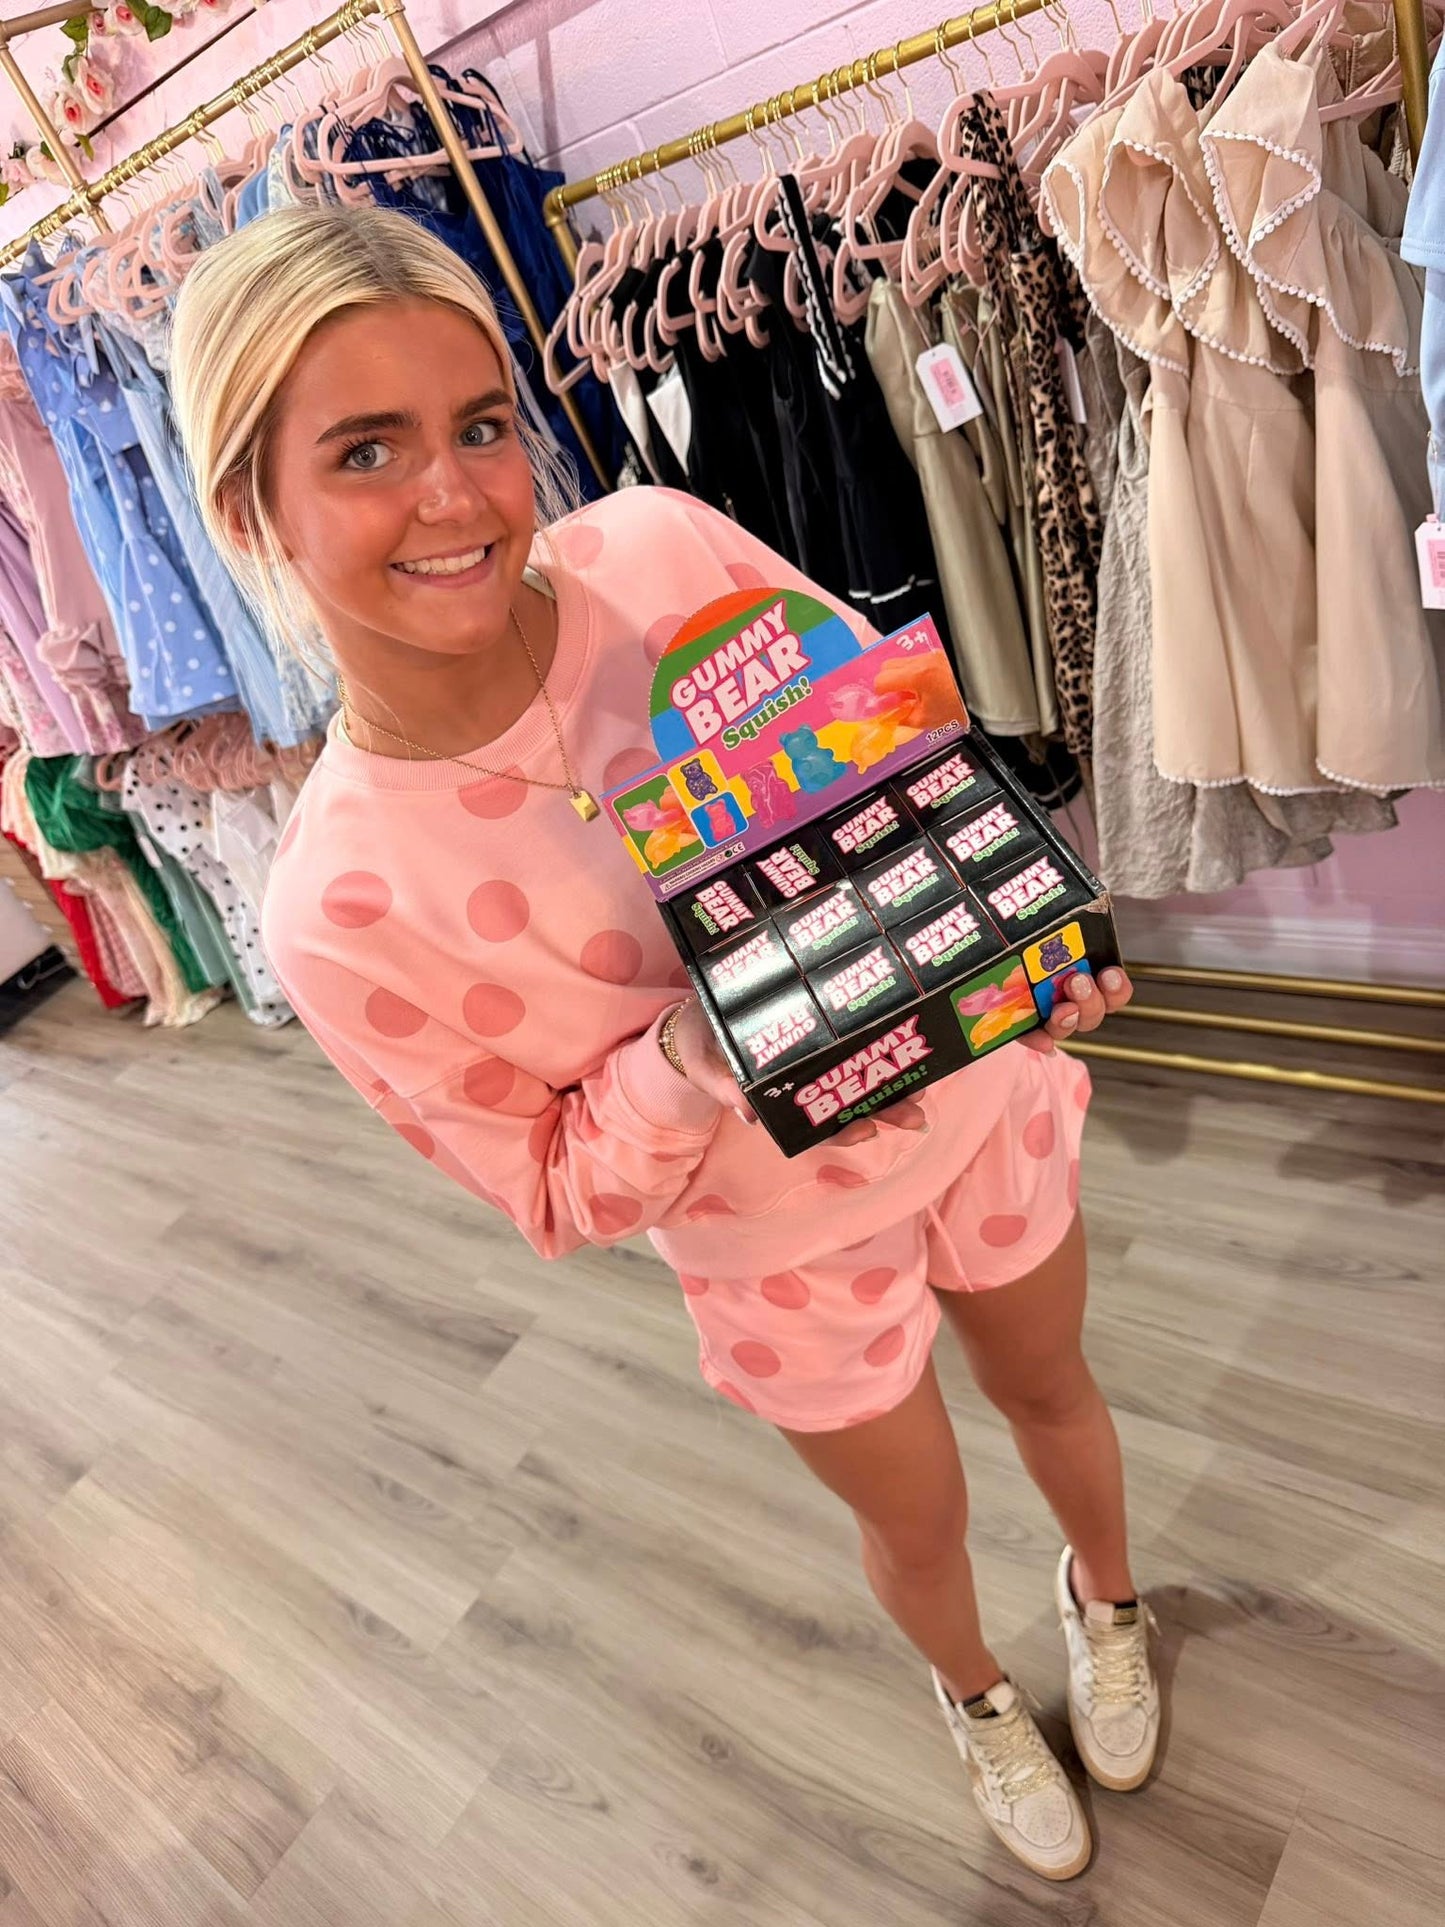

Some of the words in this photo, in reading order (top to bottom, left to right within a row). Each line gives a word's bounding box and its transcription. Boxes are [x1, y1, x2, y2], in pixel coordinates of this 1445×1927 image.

[671, 600, 786, 708] GUMMY
[896, 630, 928, 650] 3+
[684, 633, 810, 745] BEAR
[723, 677, 812, 749] Squish!
[926, 719, 960, 742] 12PCS
[906, 753, 962, 797] GUMMY
[912, 762, 975, 809] BEAR
[832, 796, 887, 841] GUMMY
[838, 806, 899, 854] BEAR
[946, 802, 1006, 848] GUMMY
[953, 812, 1019, 862] BEAR
[756, 859, 799, 898] GUMMY
[770, 847, 817, 892] BEAR
[867, 847, 927, 893] GUMMY
[874, 857, 939, 907] BEAR
[987, 855, 1050, 904] GUMMY
[994, 867, 1065, 920] BEAR
[695, 886, 740, 932] BEAR
[712, 880, 755, 920] GUMMY
[788, 890, 848, 935] GUMMY
[794, 900, 859, 949] BEAR
[905, 902, 967, 950] GUMMY
[911, 913, 981, 967] BEAR
[711, 930, 770, 976] GUMMY
[823, 945, 884, 995] GUMMY
[829, 957, 896, 1011] BEAR
[755, 1017, 817, 1071] GUMMY
[795, 1014, 919, 1107] GUMMY
[763, 1081, 795, 1098] 3+
[803, 1035, 933, 1126] BEAR
[837, 1064, 928, 1123] Squish!
